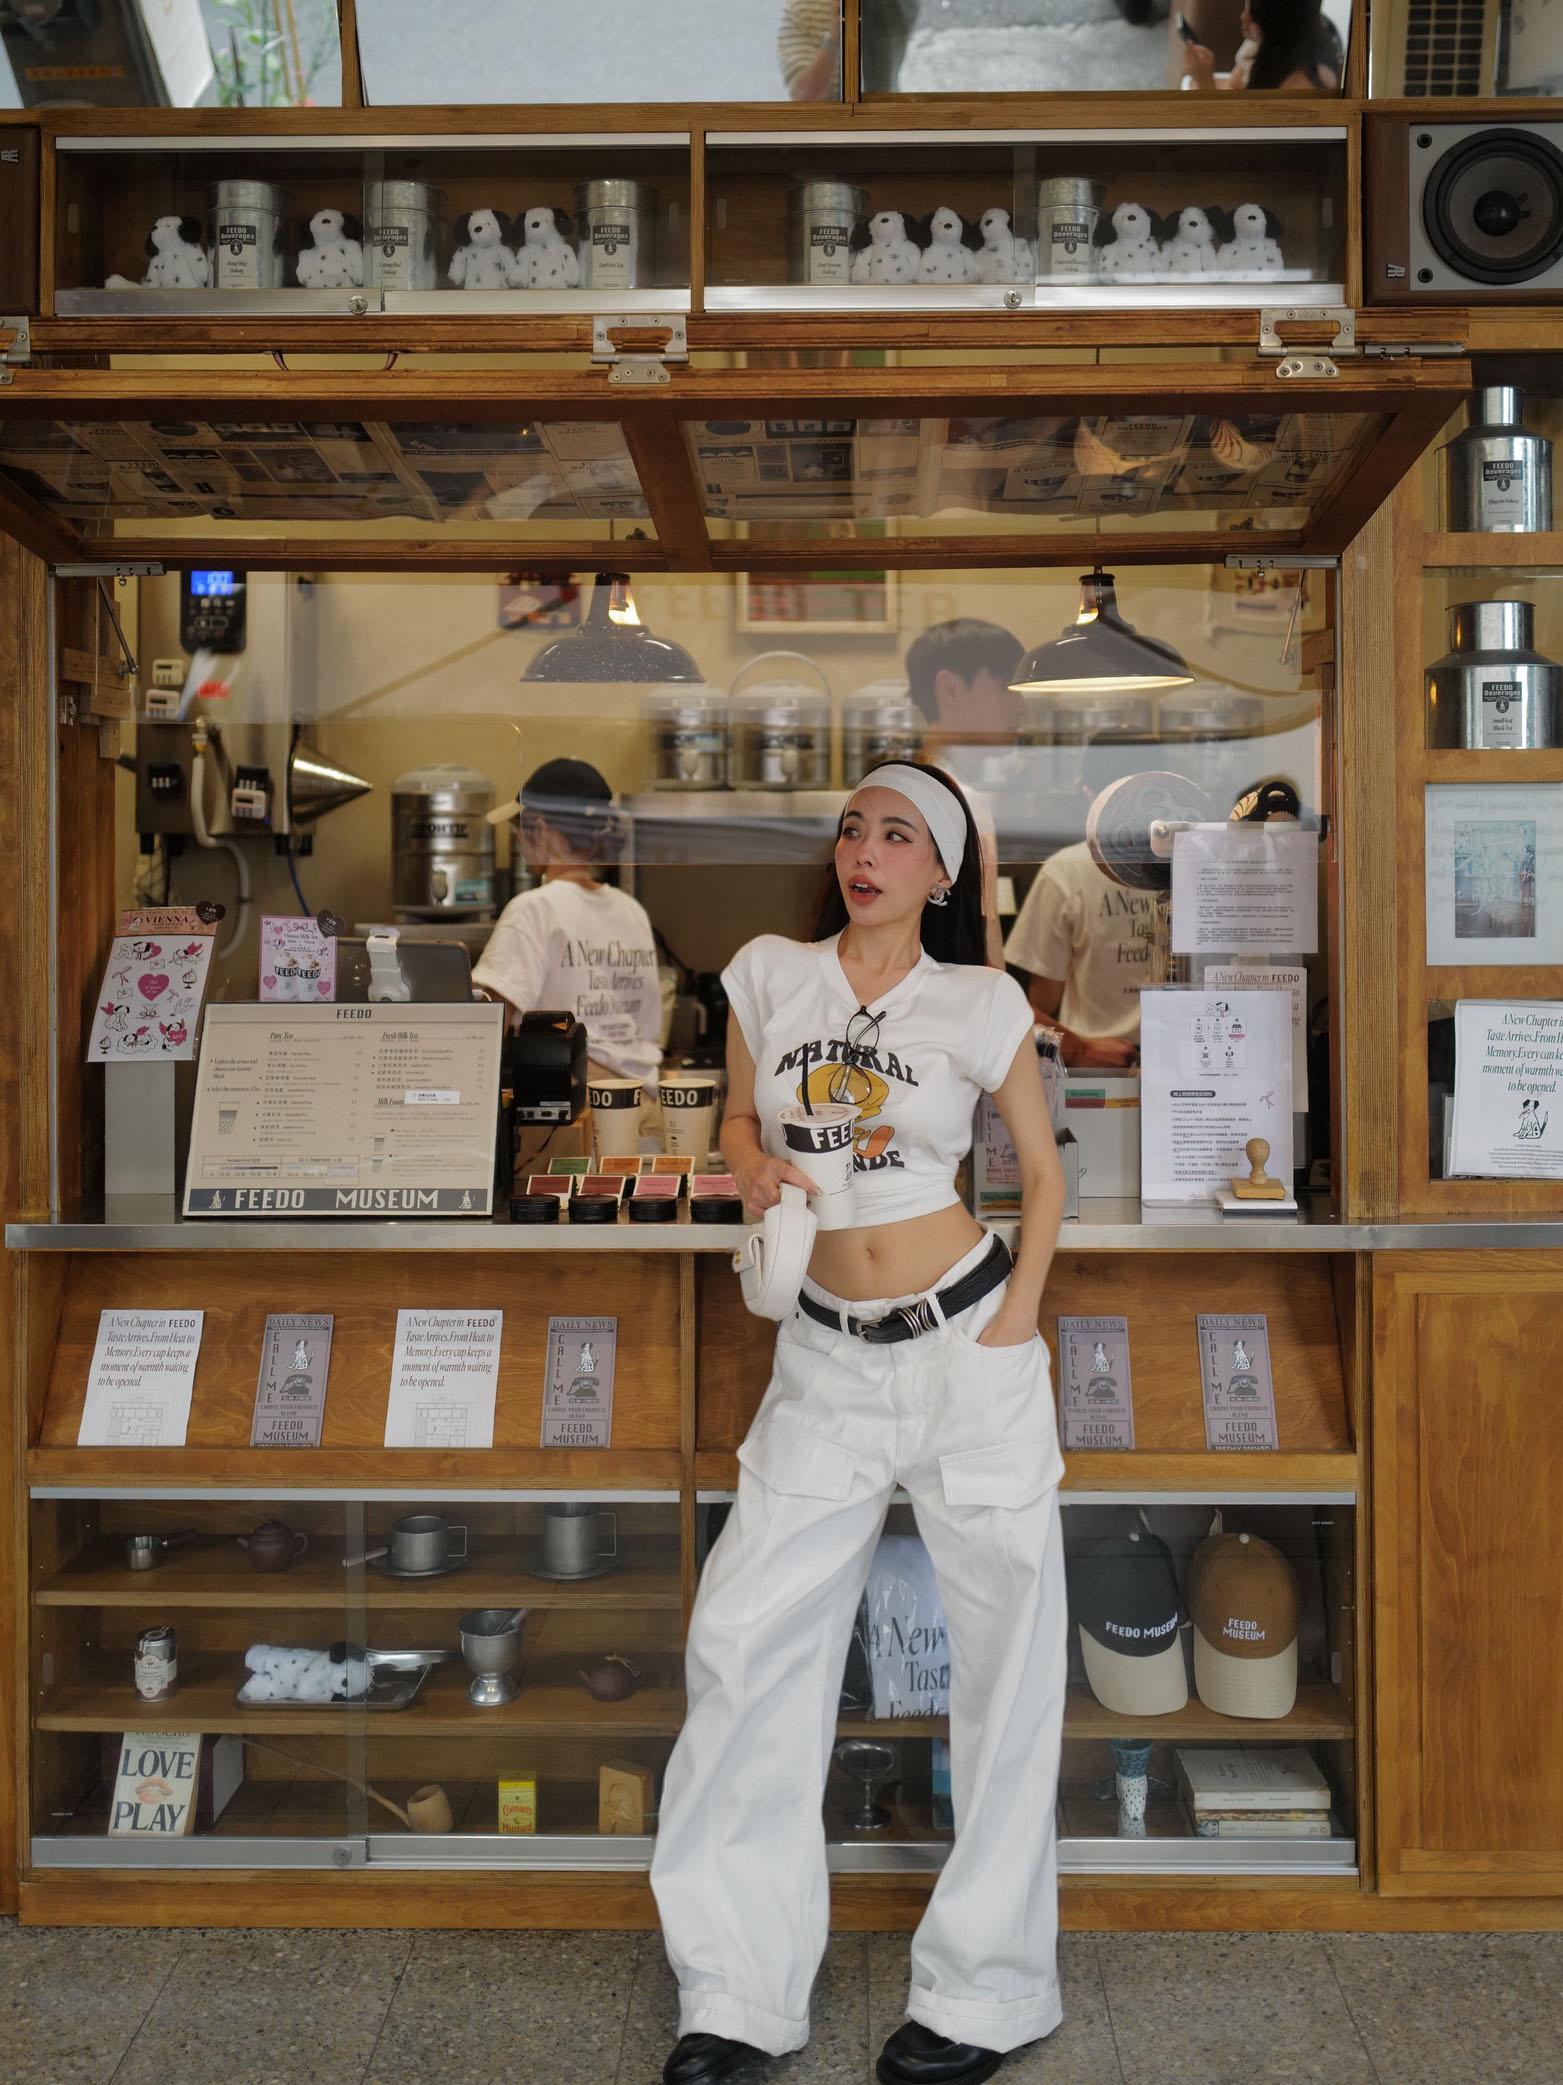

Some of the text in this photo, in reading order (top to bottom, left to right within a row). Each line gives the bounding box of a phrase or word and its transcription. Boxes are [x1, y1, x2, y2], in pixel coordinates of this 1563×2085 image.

[1492, 462, 1514, 470] FEEDO
[1100, 891, 1112, 917] A
[560, 940, 655, 974] A New Chapter
[1233, 971, 1261, 985] Chapter
[1272, 974, 1300, 982] FEEDO
[336, 1008, 372, 1019] FEEDO
[1502, 1013, 1560, 1029] A New Chapter
[382, 1032, 396, 1040] Fresh
[397, 1032, 408, 1040] Milk
[1486, 1029, 1506, 1042] Taste
[1540, 1050, 1553, 1060] can
[774, 1039, 919, 1087] NATURAL
[1482, 1064, 1554, 1078] moment of warmth
[1508, 1081, 1557, 1095] to be opened.
[810, 1120, 854, 1150] FEE
[853, 1150, 905, 1172] NDE
[234, 1190, 439, 1209] FEEDO MUSEUM
[115, 1318, 130, 1328] New
[130, 1317, 157, 1330] Chapter
[157, 1319, 166, 1328] in
[168, 1320, 196, 1328] FEEDO
[298, 1318, 329, 1326] NEWS
[412, 1317, 428, 1328] New
[428, 1316, 454, 1330] Chapter
[455, 1318, 464, 1328] in
[467, 1318, 496, 1328] FEEDO
[585, 1320, 613, 1328] NEWS
[1063, 1320, 1124, 1328] DAILY NEWS
[1201, 1318, 1264, 1326] DAILY NEWS
[107, 1331, 125, 1343] Taste
[406, 1331, 424, 1342] Taste
[153, 1349, 166, 1360] cup
[167, 1346, 184, 1360] keeps
[454, 1349, 467, 1360] cup
[467, 1346, 486, 1360] keeps
[100, 1362, 190, 1374] moment of warmth waiting
[402, 1362, 493, 1374] moment of warmth waiting
[105, 1376, 114, 1387] be
[408, 1376, 418, 1387] be
[272, 1420, 304, 1430] FEEDO
[561, 1424, 592, 1434] FEEDO
[1083, 1424, 1115, 1434] FEEDO
[1225, 1422, 1258, 1432] FEEDO
[263, 1432, 309, 1440] MUSEUM
[552, 1434, 598, 1444] MUSEUM
[1076, 1435, 1122, 1445] MUSEUM
[1218, 1434, 1265, 1443] MUSEUM
[1105, 1612, 1179, 1639] FEEDO MUSEUM
[1228, 1618, 1258, 1630] FEEDO
[888, 1617, 947, 1656] New
[1222, 1628, 1266, 1640] MUSEUM
[120, 1749, 196, 1779] LOVE
[112, 1801, 186, 1832] PLAY
[502, 1822, 532, 1832] Mustard
